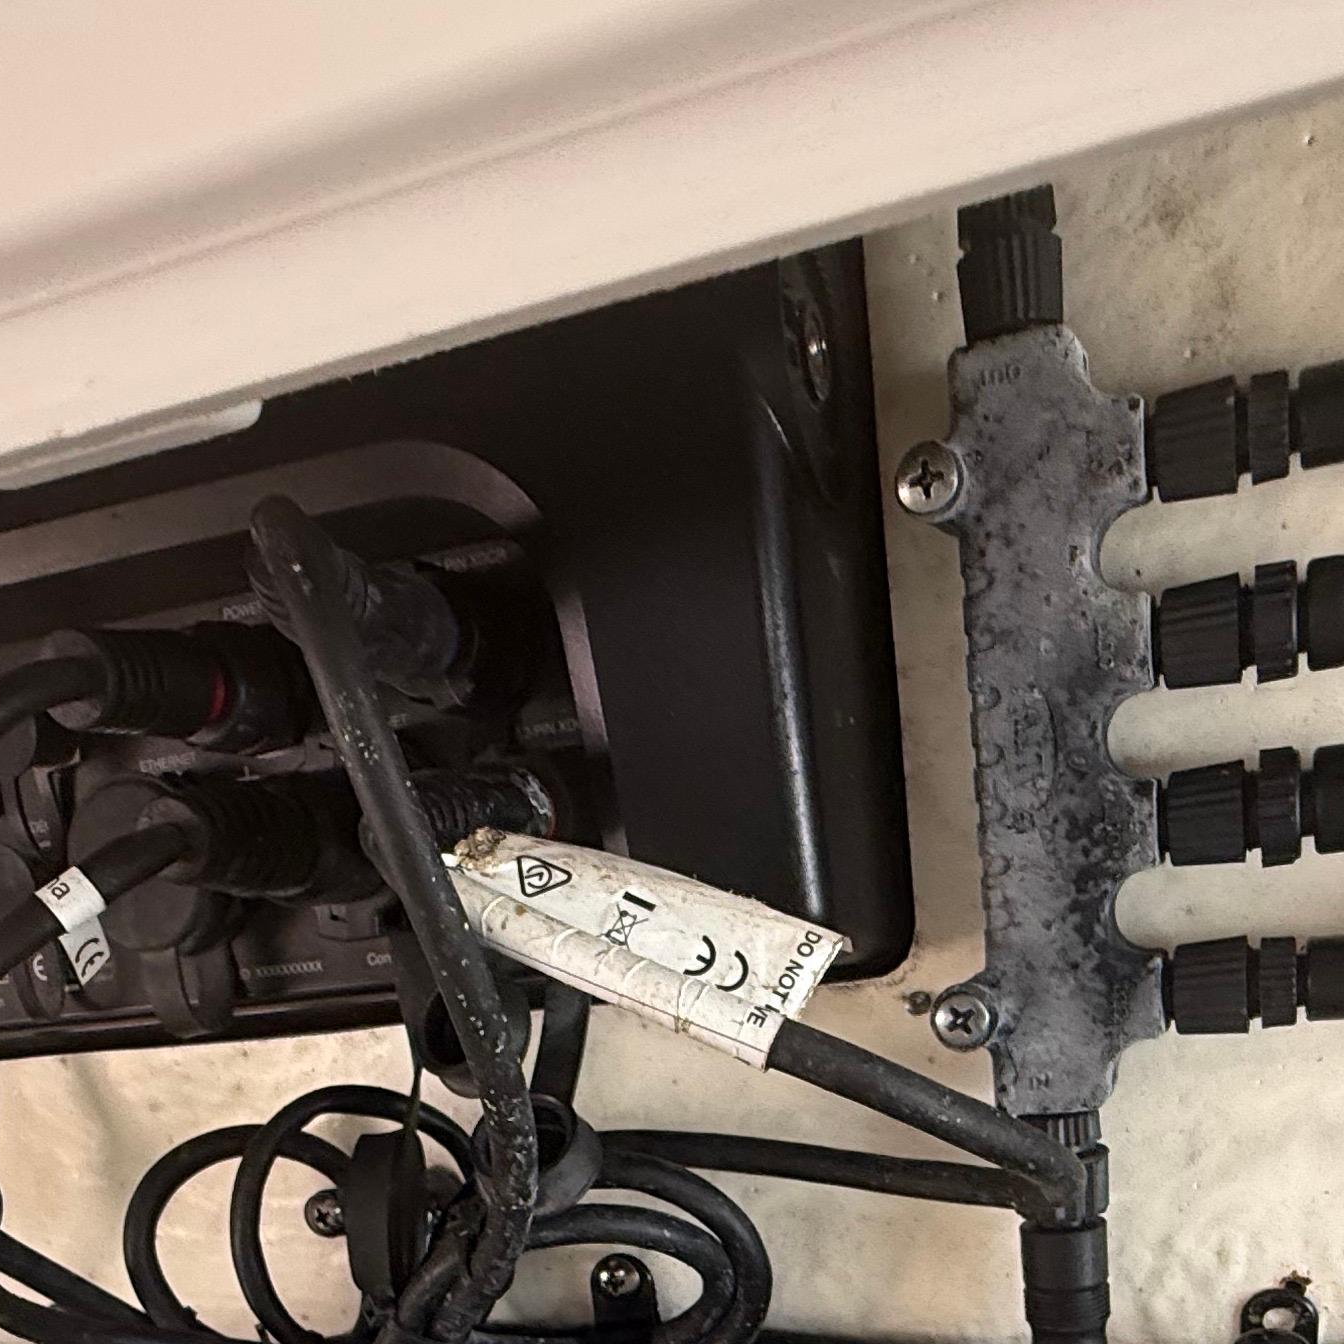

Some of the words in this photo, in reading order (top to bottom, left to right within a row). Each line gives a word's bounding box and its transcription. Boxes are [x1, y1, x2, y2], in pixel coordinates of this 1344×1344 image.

[222, 601, 262, 621] POWE
[797, 930, 823, 957] DO
[772, 959, 805, 1004] NOT
